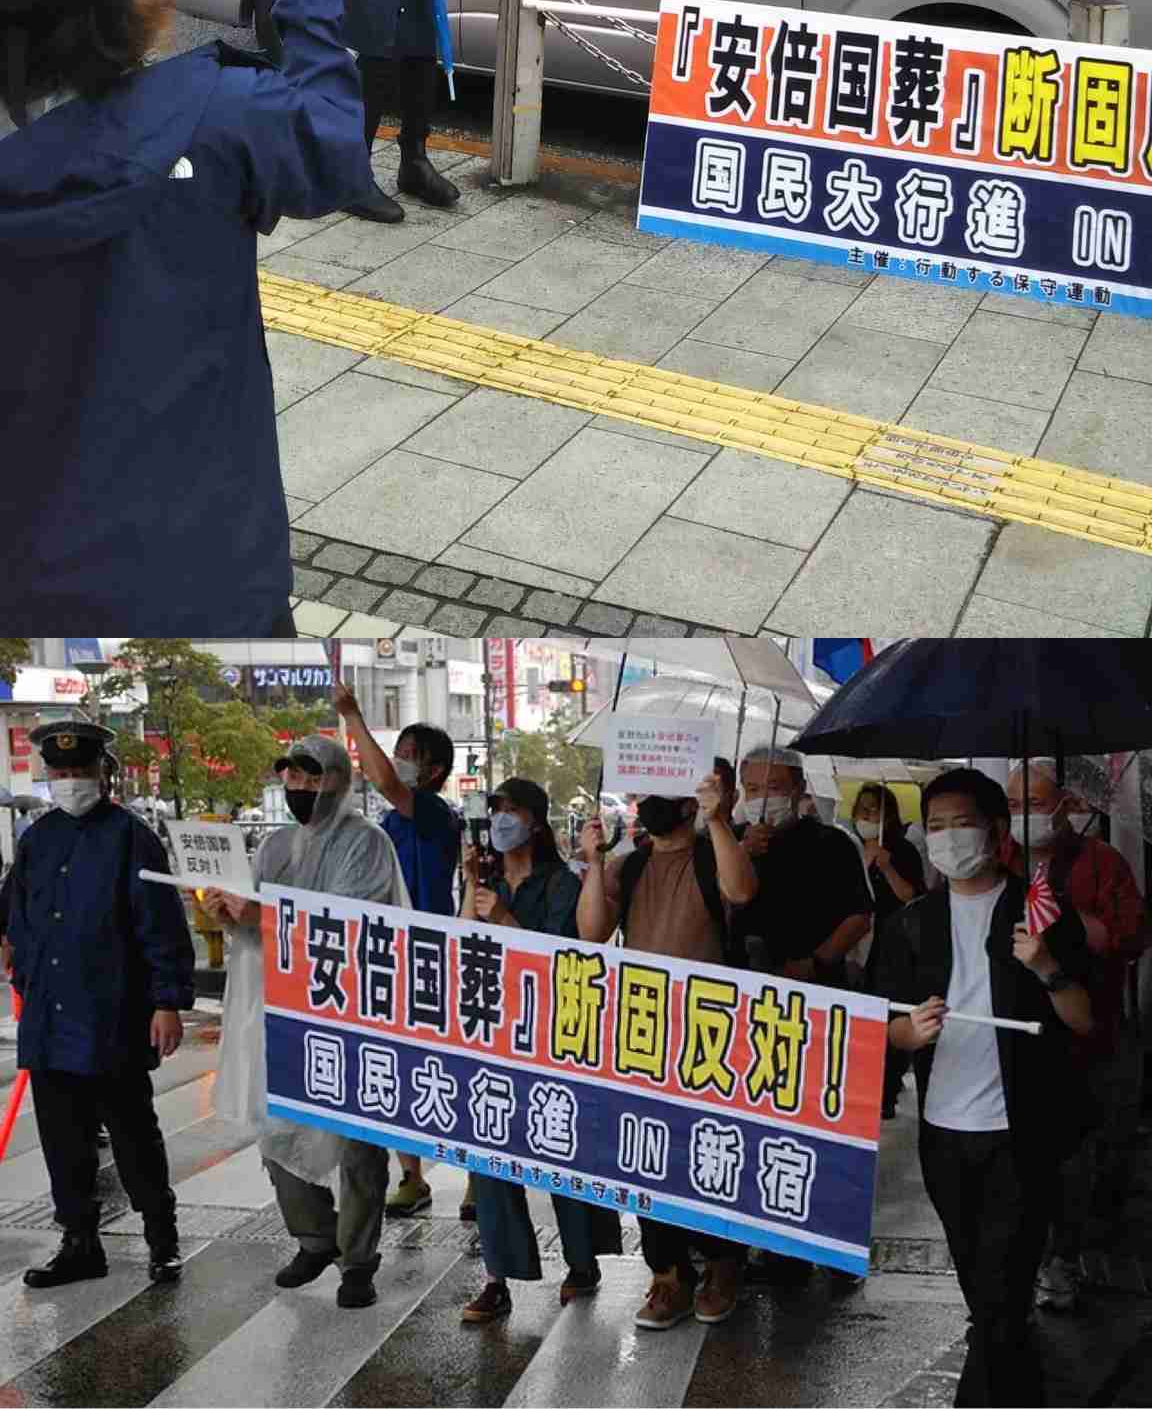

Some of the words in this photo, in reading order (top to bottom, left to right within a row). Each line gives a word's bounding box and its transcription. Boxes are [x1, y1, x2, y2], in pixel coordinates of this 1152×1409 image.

[671, 5, 1152, 178] 『安倍国葬』断固
[695, 139, 1024, 258] 国民大行進
[1074, 208, 1131, 271] IN
[278, 898, 847, 1118] 『安倍国葬』断固反対！
[306, 1033, 578, 1162] 国民大行進
[619, 1113, 669, 1178] IN
[691, 1118, 815, 1222] 新宿
